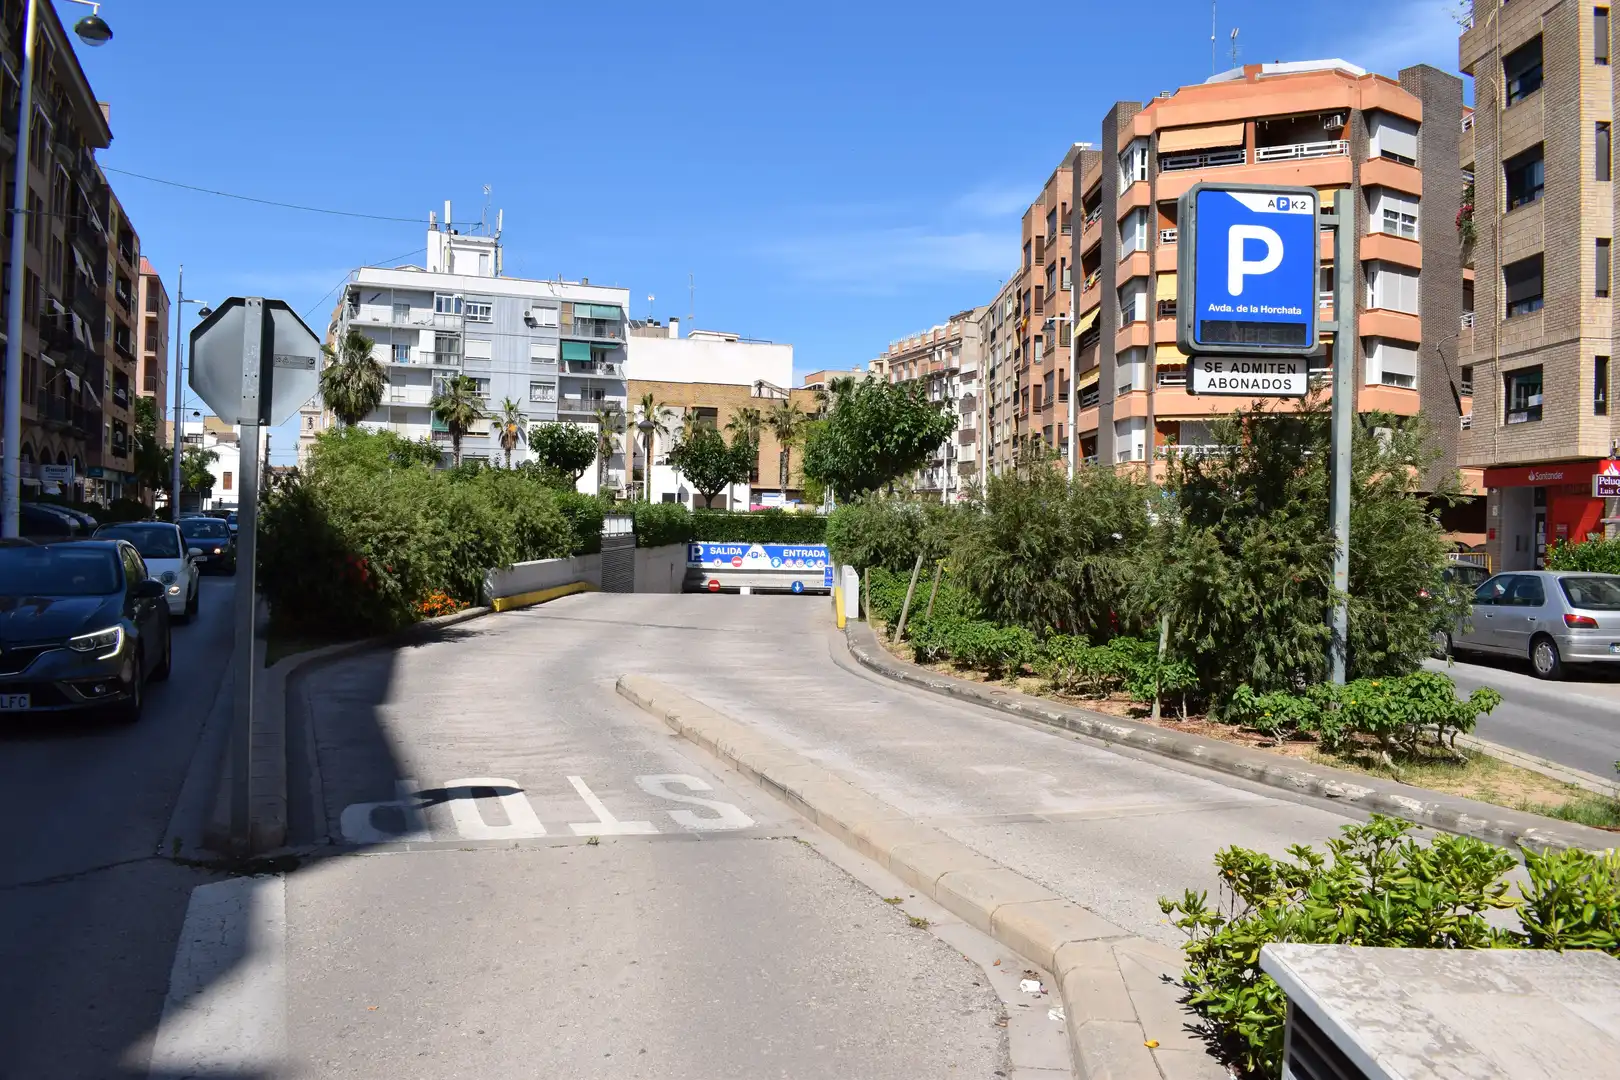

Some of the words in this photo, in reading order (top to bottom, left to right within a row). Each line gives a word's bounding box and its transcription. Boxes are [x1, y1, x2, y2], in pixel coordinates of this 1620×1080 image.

[1228, 224, 1284, 296] P
[1208, 303, 1234, 313] Avda.
[1236, 304, 1248, 313] de
[1250, 305, 1258, 314] la
[1260, 305, 1302, 315] Horchata
[1204, 362, 1223, 373] SE
[1231, 362, 1297, 374] ADMITEN
[1207, 378, 1292, 390] ABONADOS
[1535, 471, 1564, 481] Santander
[1600, 487, 1614, 495] Luis
[691, 545, 704, 561] P
[710, 547, 743, 556] SALIDA
[783, 549, 826, 558] ENTRADA
[340, 773, 756, 843] STOP
